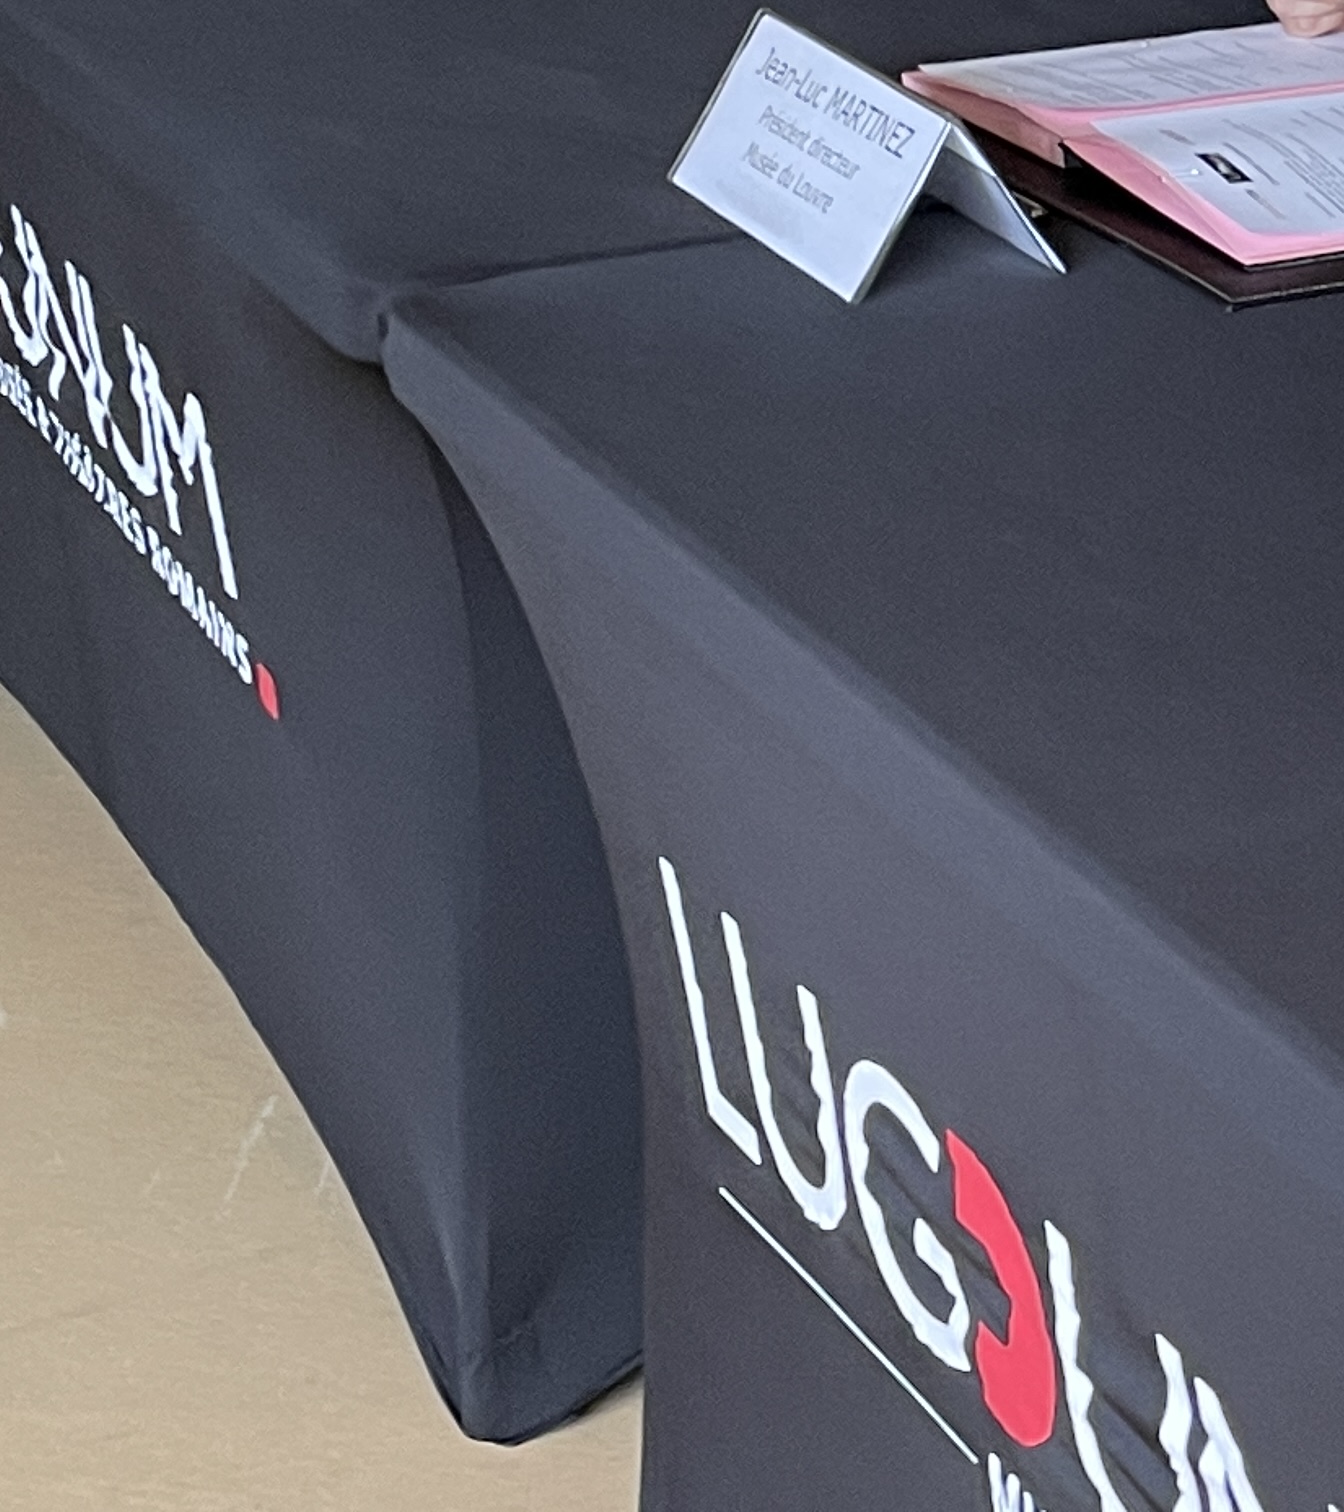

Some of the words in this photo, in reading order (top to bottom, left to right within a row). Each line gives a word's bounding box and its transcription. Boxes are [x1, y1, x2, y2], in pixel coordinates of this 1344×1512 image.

[755, 46, 828, 109] Jean-Luc
[823, 86, 916, 159] MARTINEZ
[792, 172, 834, 214] Louvre
